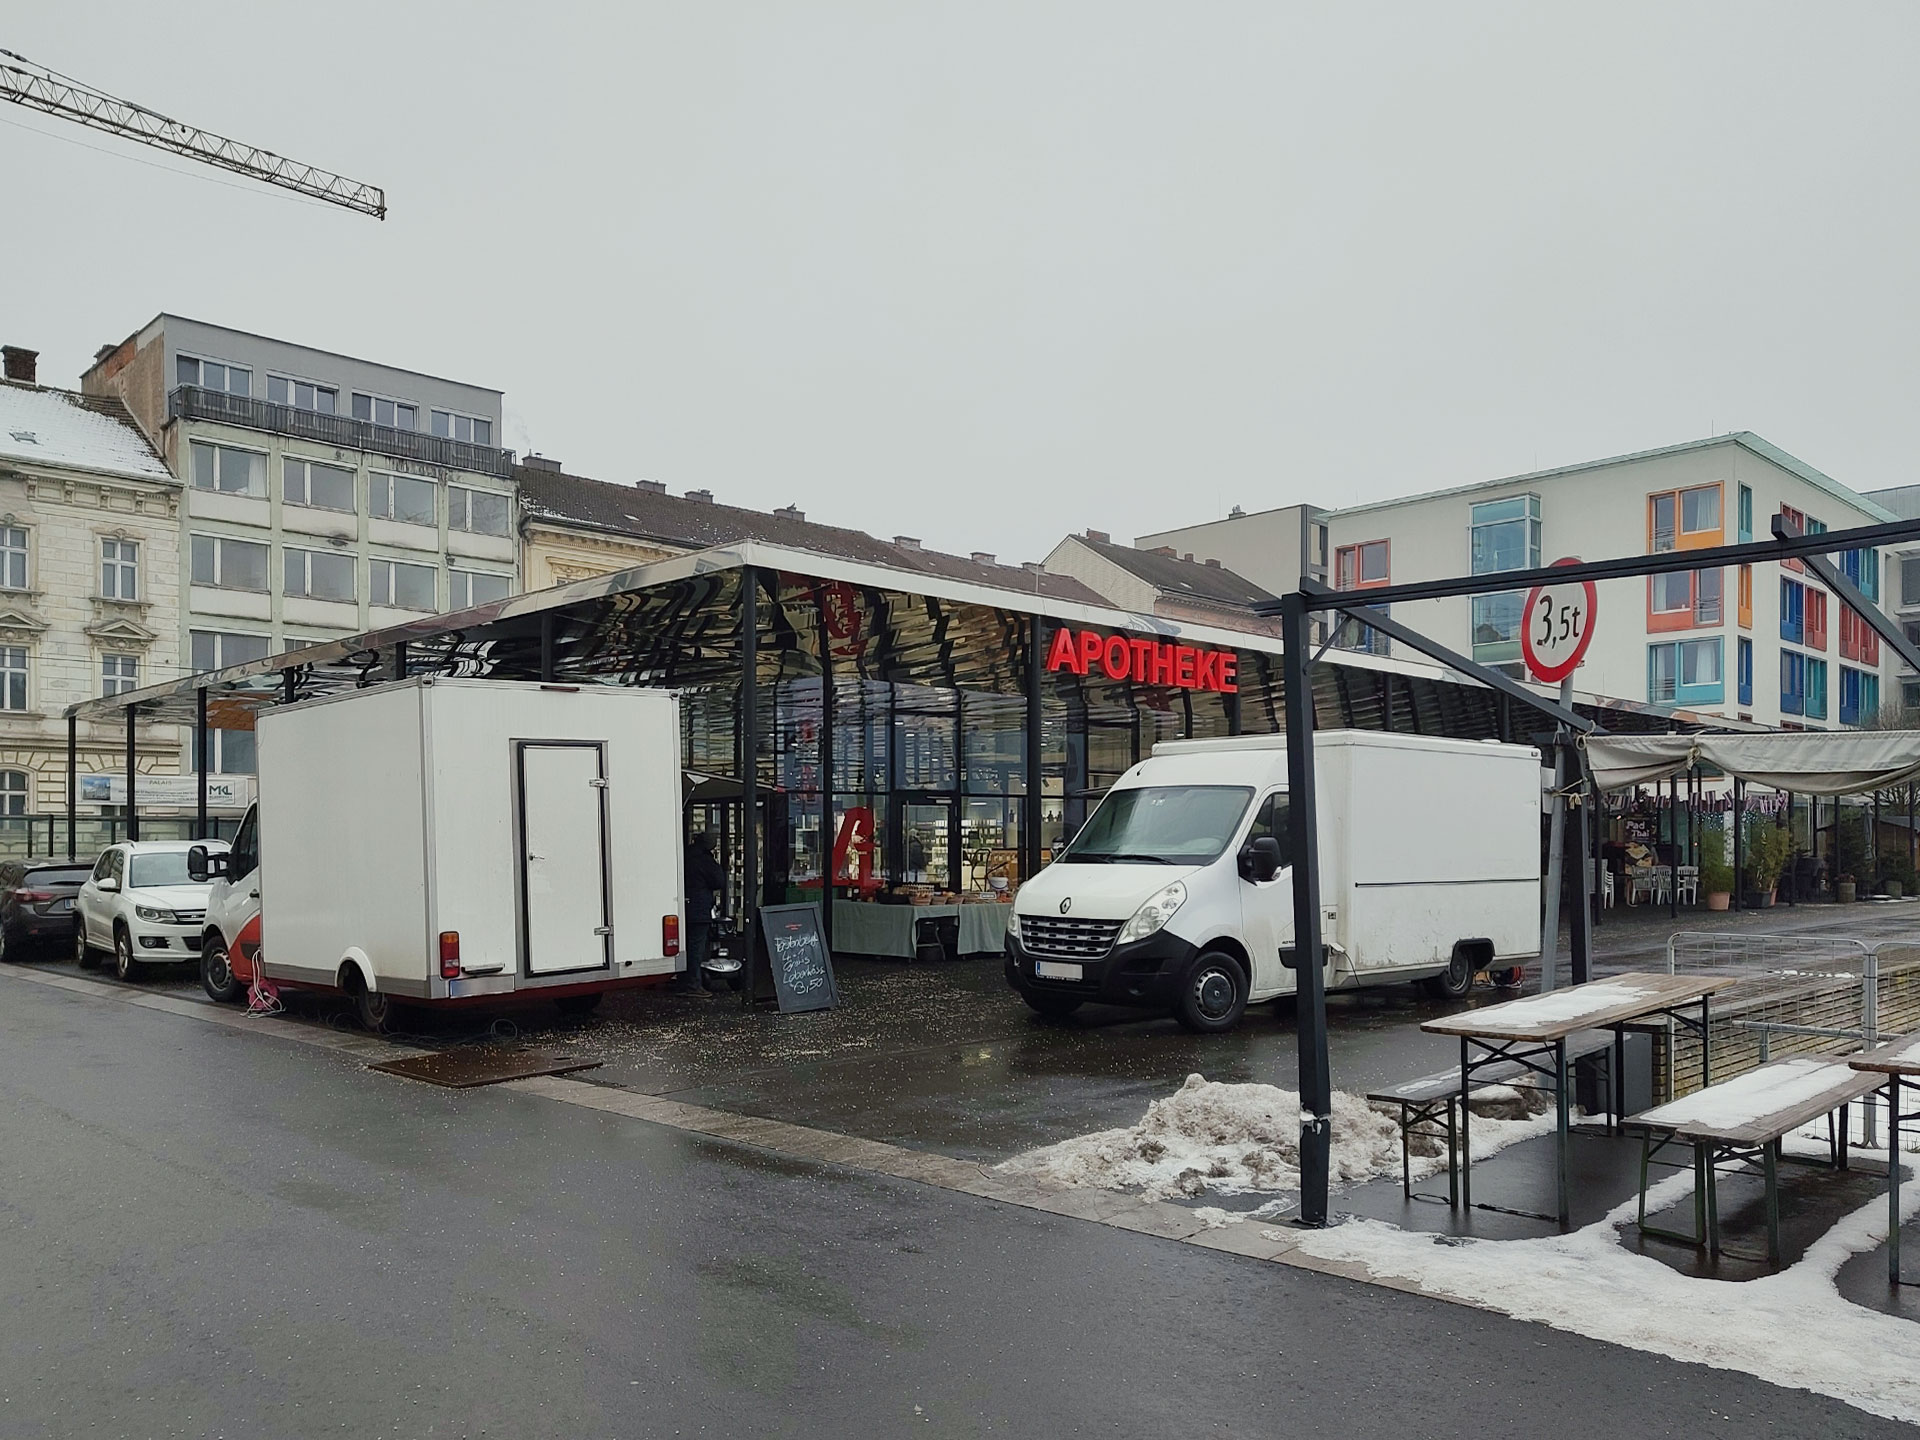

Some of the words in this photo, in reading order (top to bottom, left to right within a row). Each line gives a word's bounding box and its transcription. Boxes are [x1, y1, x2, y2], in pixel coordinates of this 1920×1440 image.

[1537, 595, 1580, 650] 3,5t
[1047, 627, 1238, 693] APOTHEKE
[1626, 821, 1645, 830] Pad
